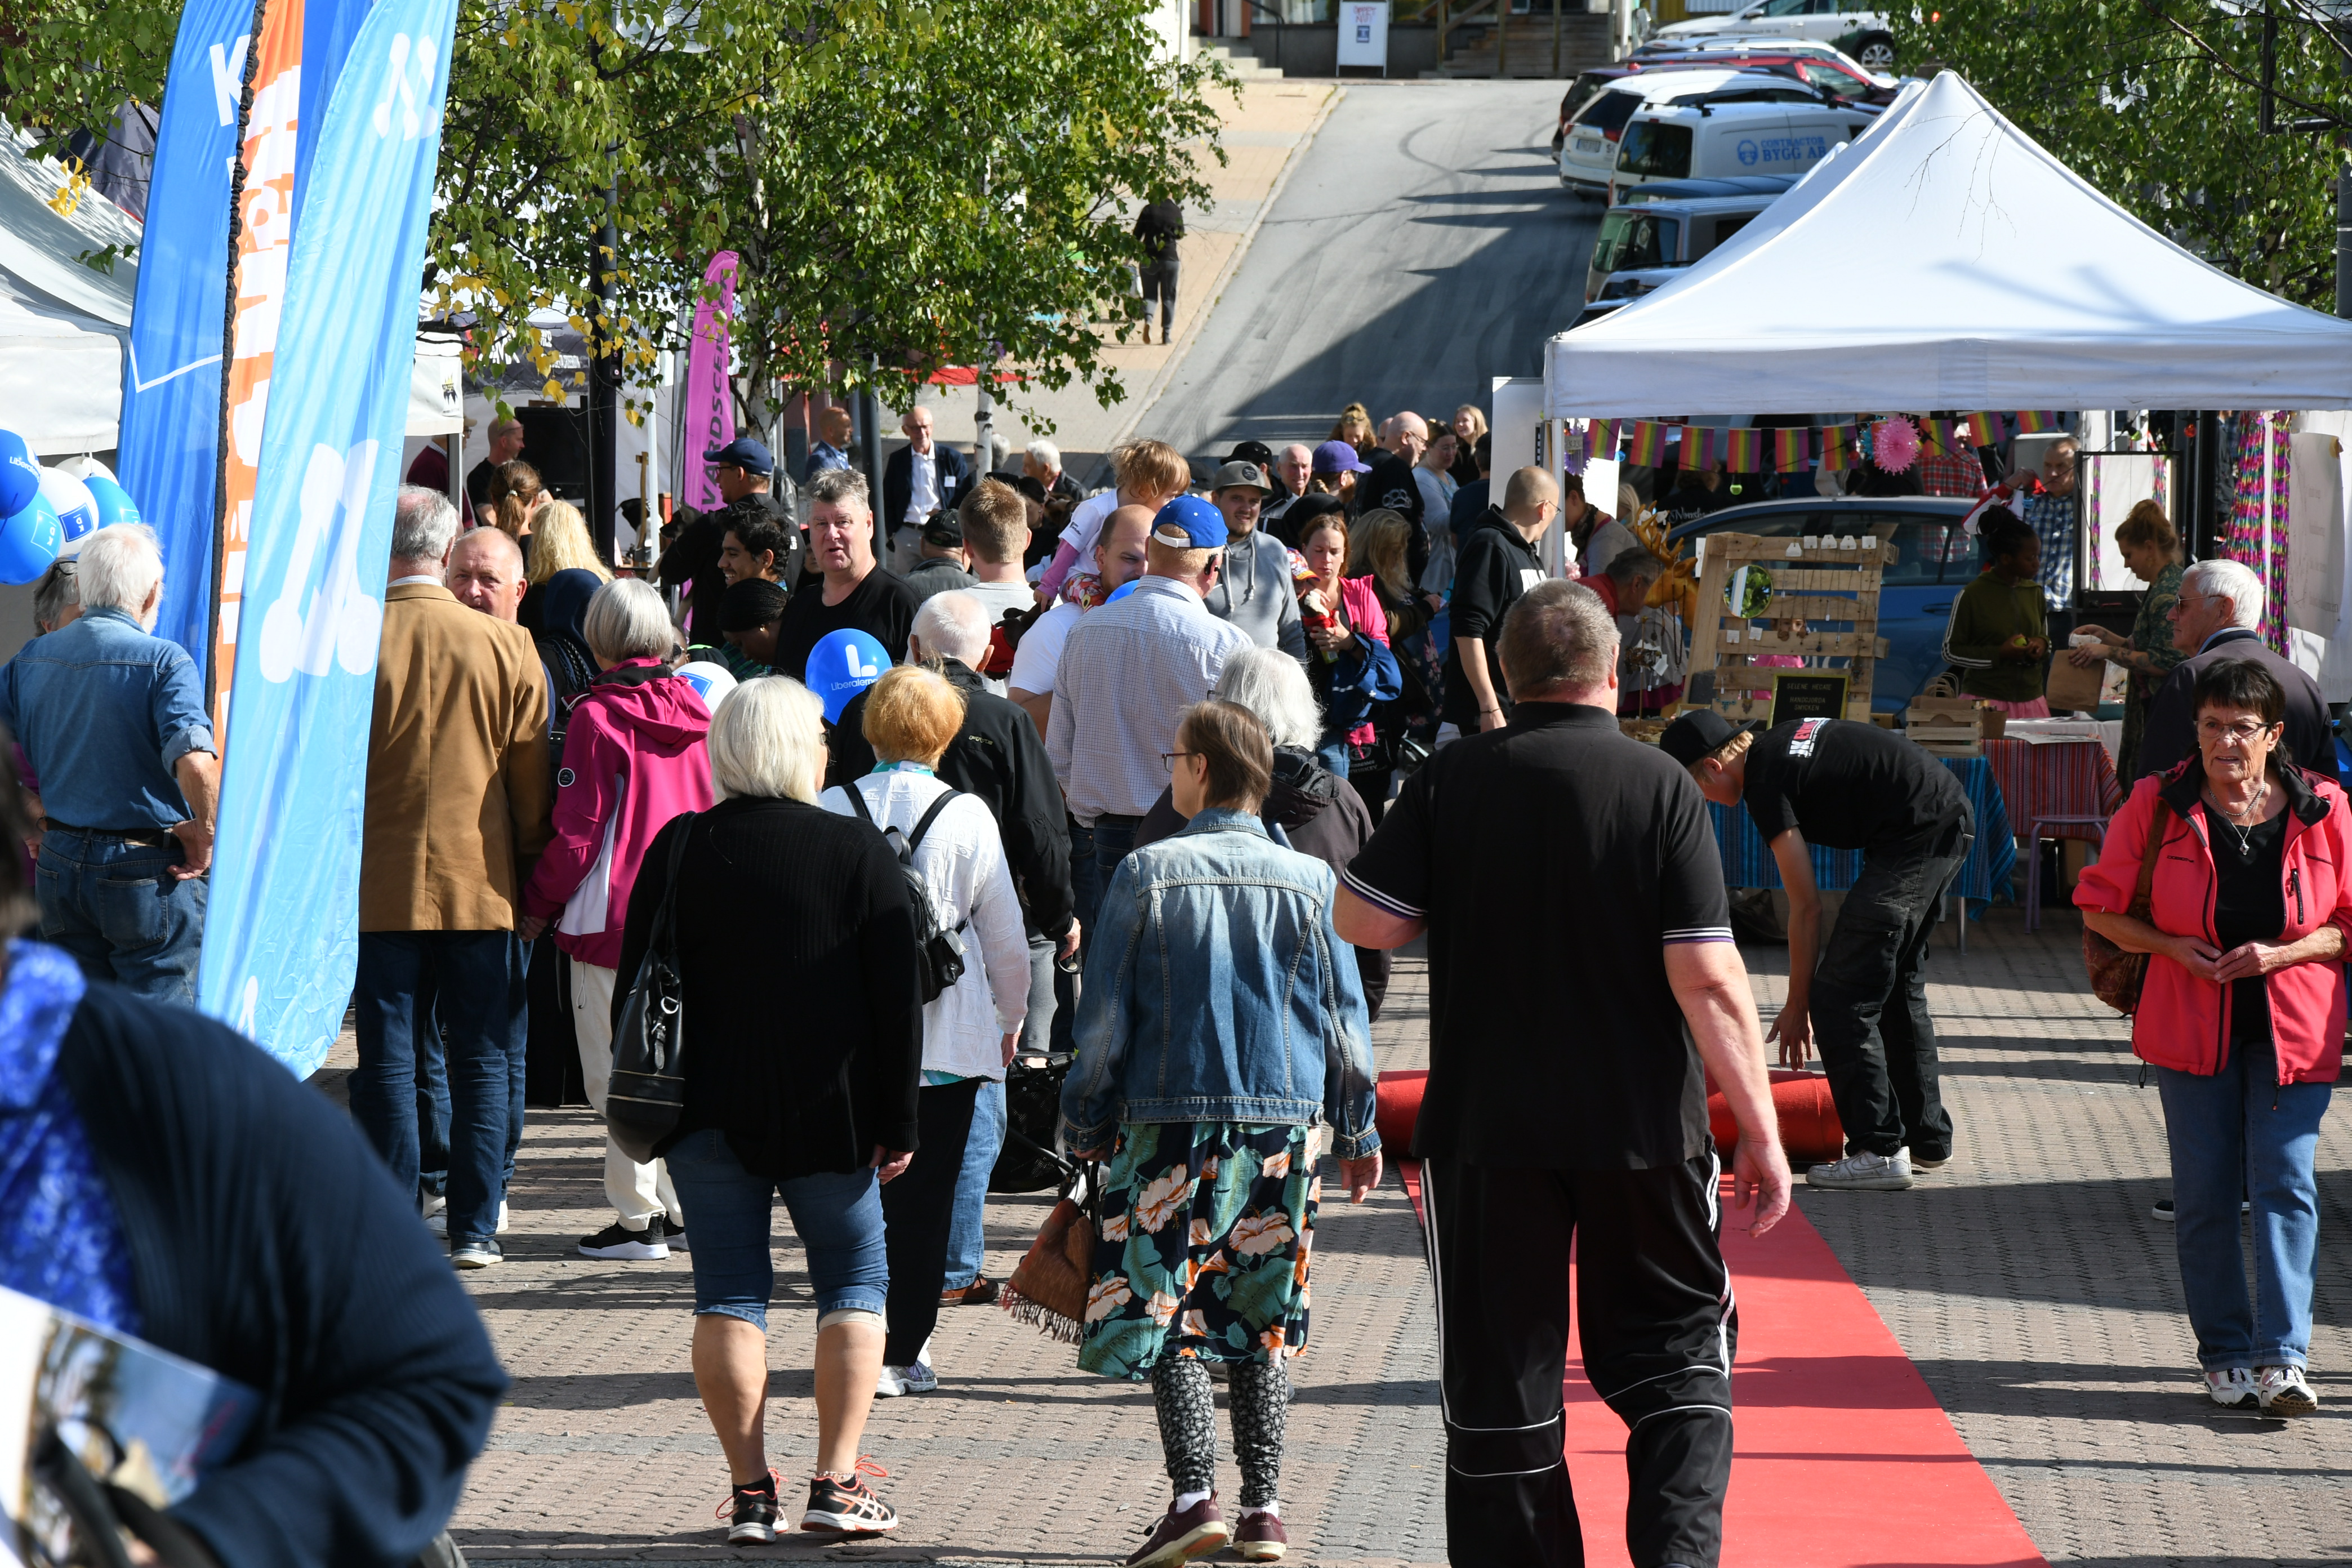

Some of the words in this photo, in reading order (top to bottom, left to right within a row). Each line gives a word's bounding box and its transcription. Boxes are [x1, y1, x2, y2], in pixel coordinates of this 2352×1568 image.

[1761, 137, 1825, 148] CONTRACTOR
[1762, 148, 1801, 162] BYGG
[1807, 146, 1827, 159] AB
